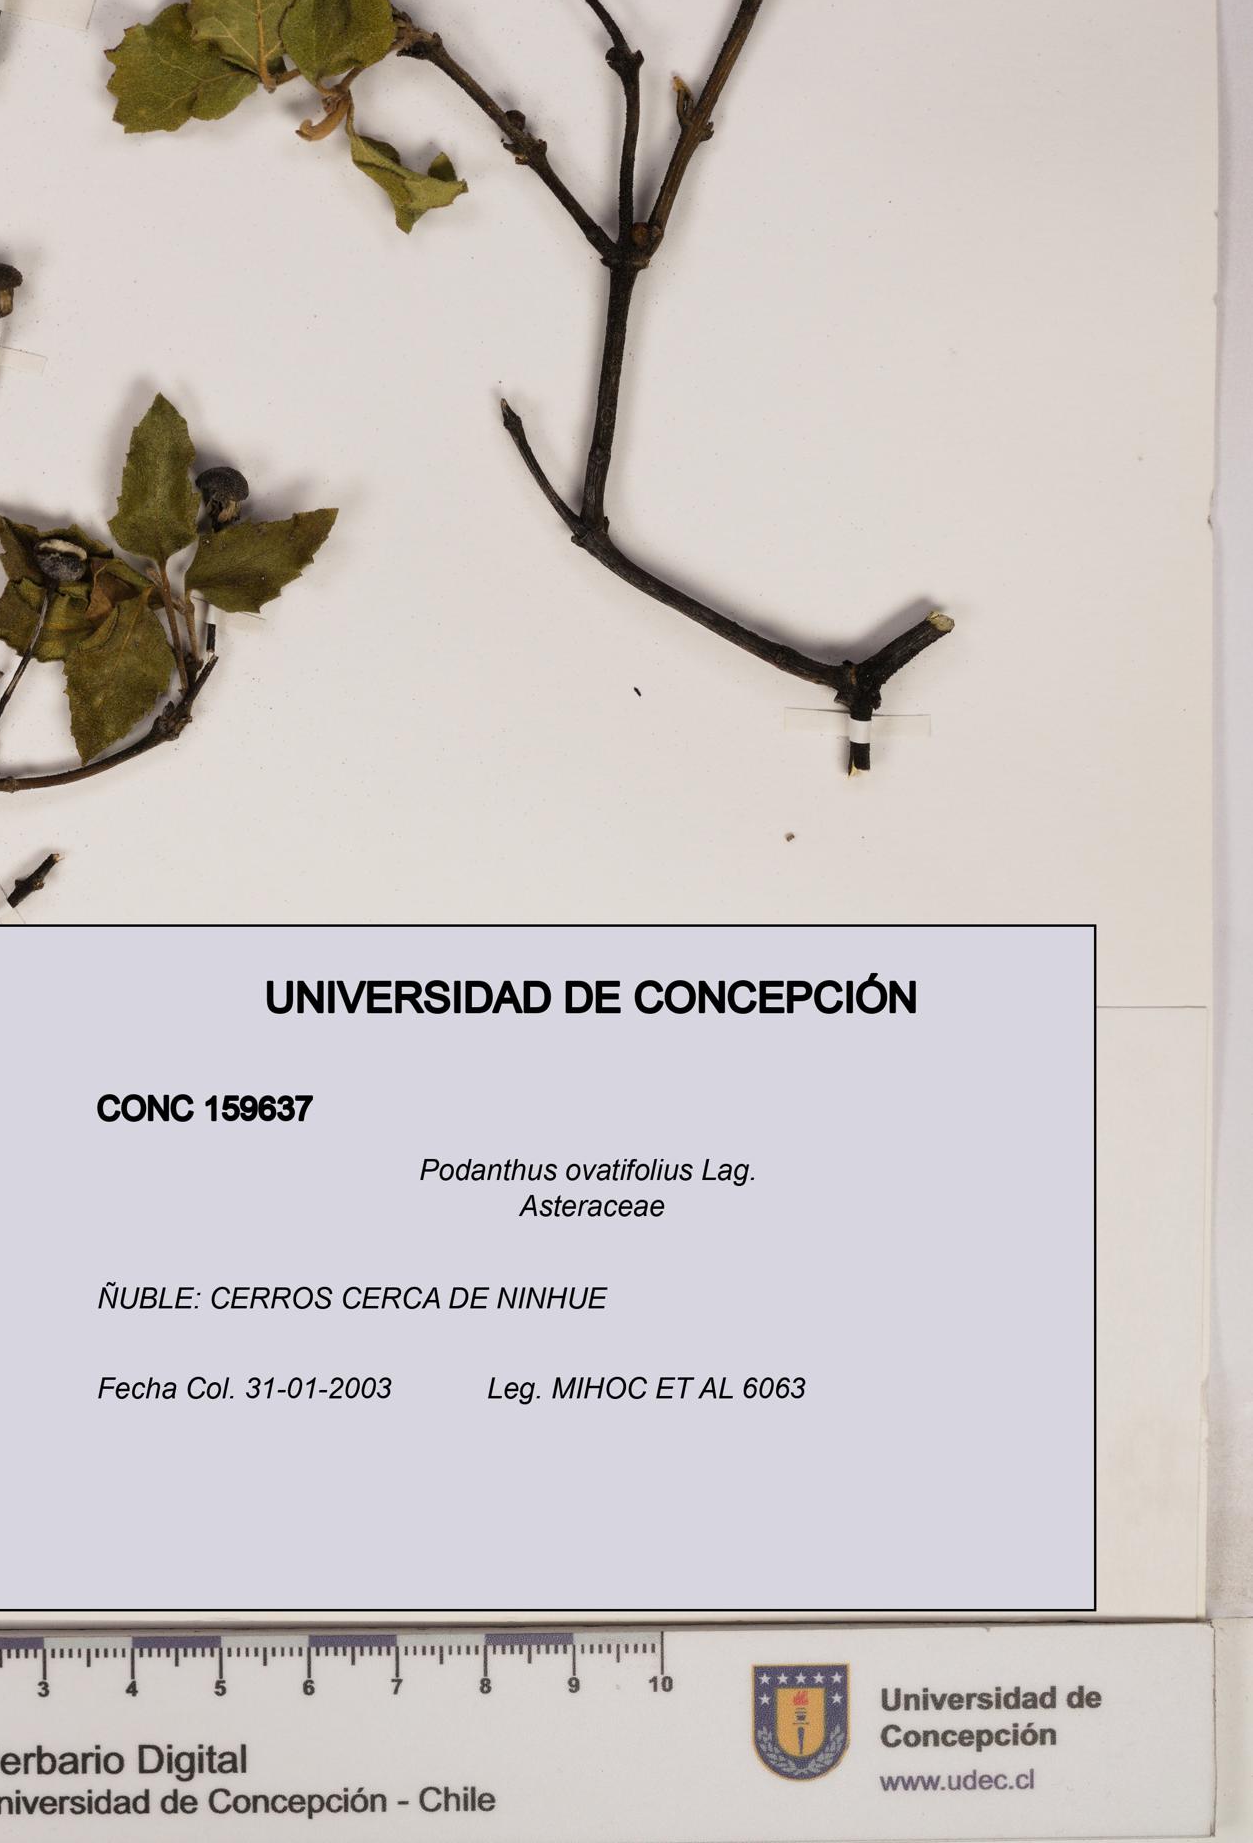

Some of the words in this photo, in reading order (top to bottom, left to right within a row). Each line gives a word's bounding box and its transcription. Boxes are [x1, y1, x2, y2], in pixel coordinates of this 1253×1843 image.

[36, 1680, 51, 1698] 3
[124, 1680, 140, 1697] 4
[213, 1679, 228, 1697] 5
[301, 1678, 317, 1696] 6
[389, 1677, 405, 1695] 7
[478, 1677, 494, 1695] 8
[566, 1676, 582, 1694] 9
[647, 1674, 675, 1694] 10
[881, 1685, 1057, 1712] Universidad
[1065, 1685, 1102, 1710] de
[880, 1722, 1057, 1753] Concepción
[137, 1743, 247, 1778] Digital
[879, 1767, 1035, 1792] www.udec.cl
[160, 1788, 199, 1815] de
[207, 1786, 388, 1820] Concepción
[418, 1785, 496, 1813] Chile
